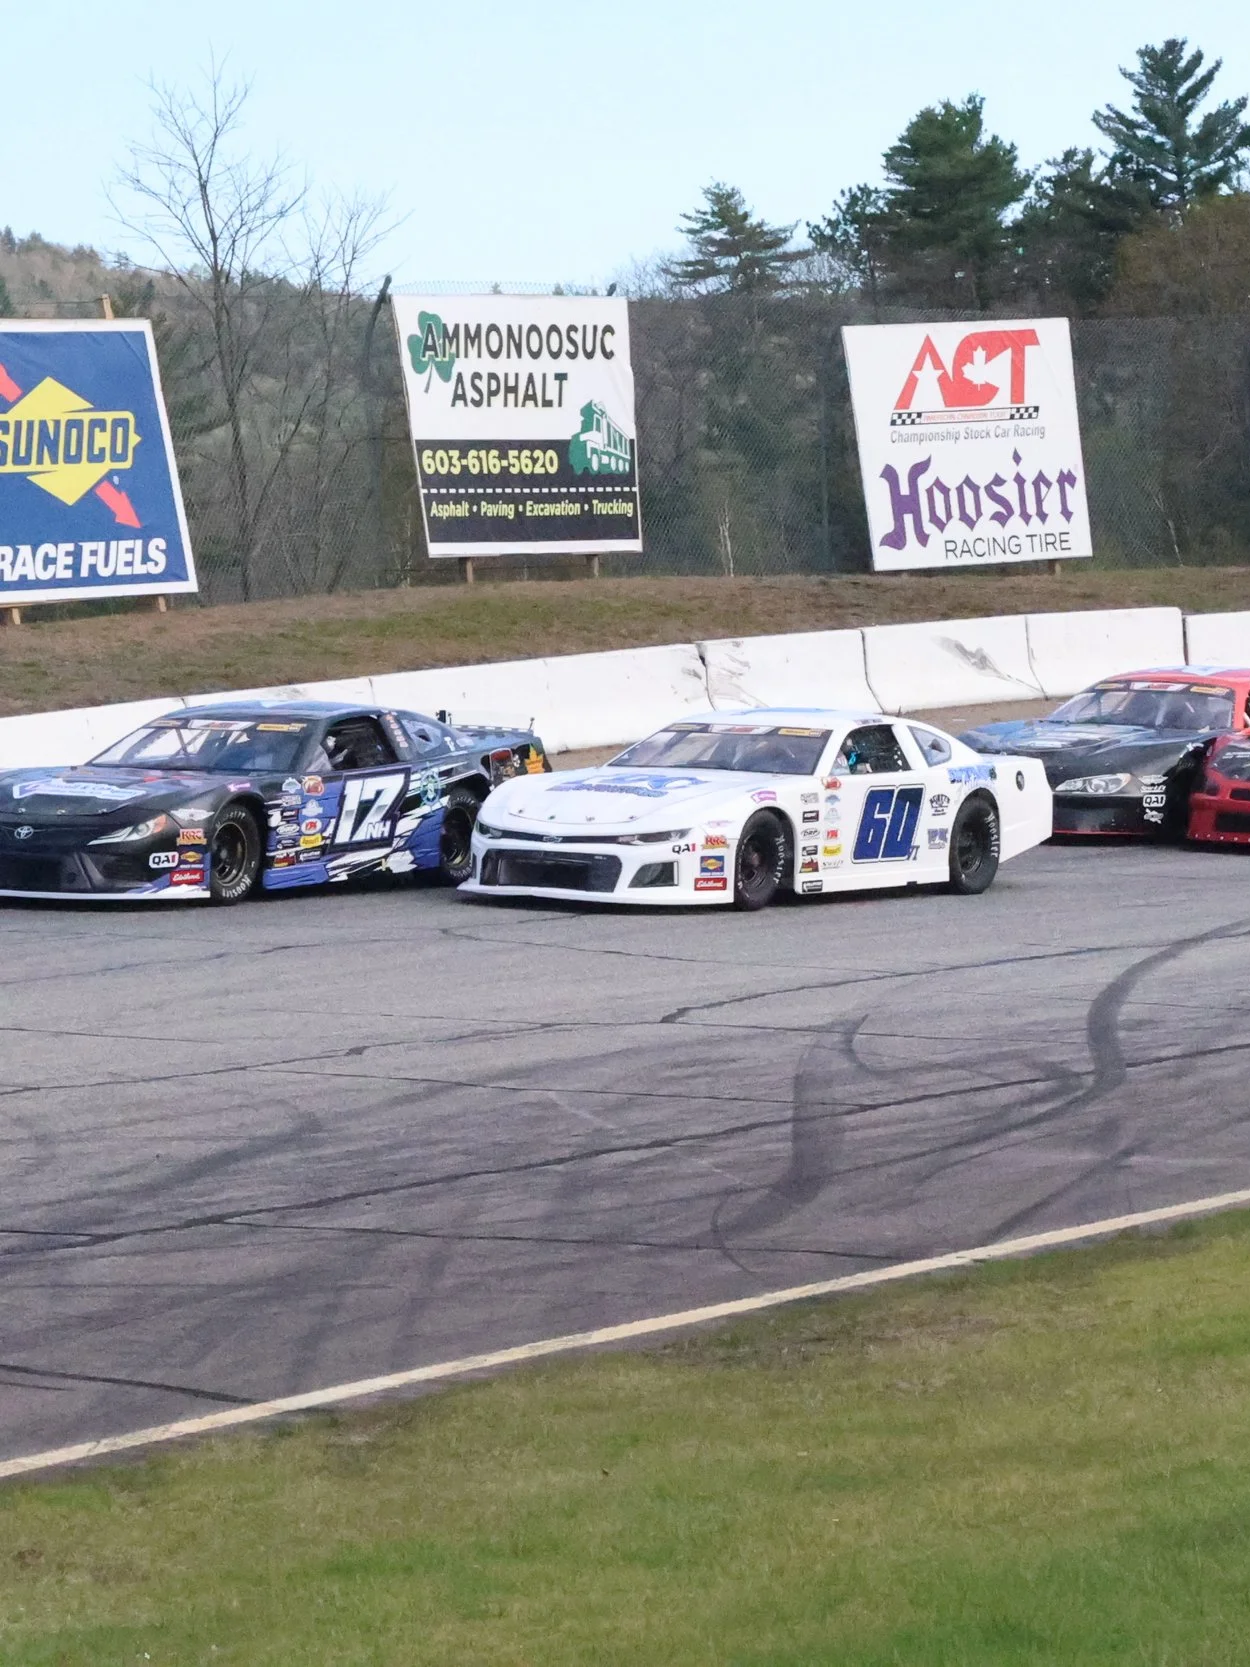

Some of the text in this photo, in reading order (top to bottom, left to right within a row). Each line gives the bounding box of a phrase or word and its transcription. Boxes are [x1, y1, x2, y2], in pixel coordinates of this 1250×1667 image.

[421, 322, 616, 360] AMMONOOSUC
[893, 328, 1040, 410] ACT
[451, 372, 568, 408] ASPHALT
[890, 424, 1046, 445] Championship Stock Car Racing
[422, 449, 559, 475] 603-616-5620
[430, 498, 634, 520] Asphalt Paving Excavation Trucking
[879, 446, 1078, 550] Hoosier
[0, 537, 167, 581] RACE FUELS
[945, 532, 1072, 559] RACING TIRE
[333, 773, 406, 845] 17
[852, 784, 925, 863] 60
[366, 821, 391, 839] NH
